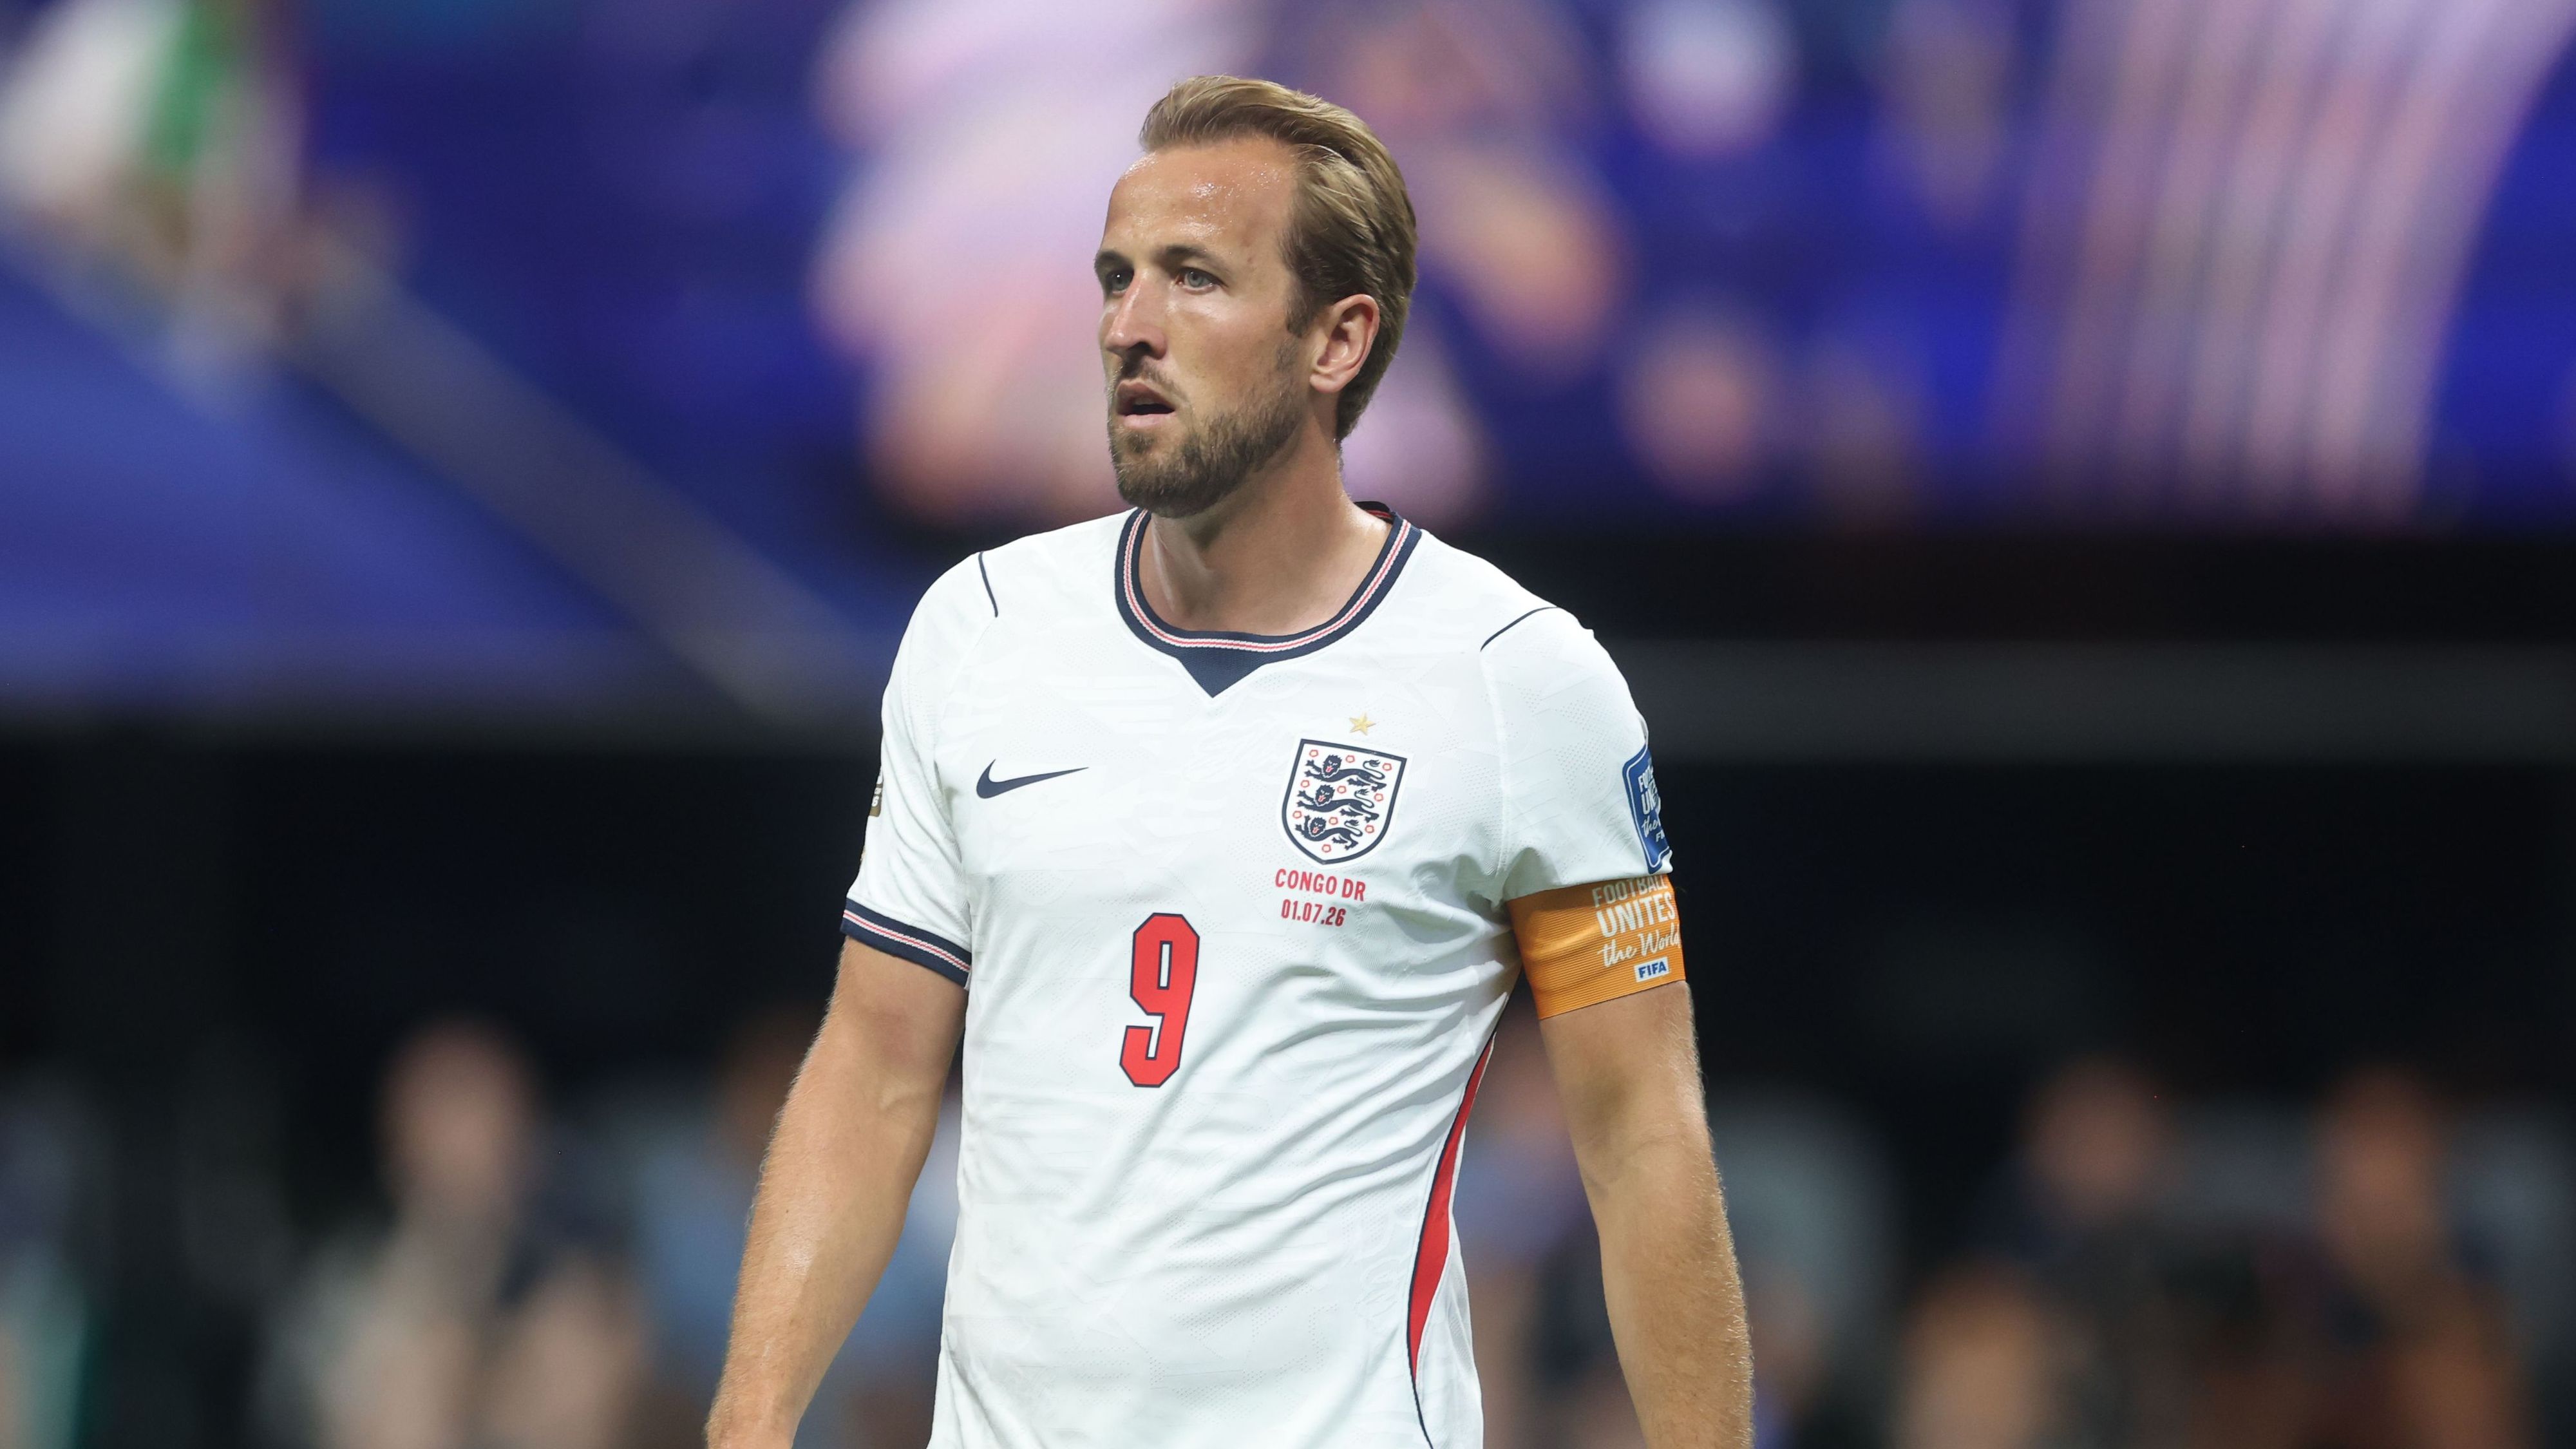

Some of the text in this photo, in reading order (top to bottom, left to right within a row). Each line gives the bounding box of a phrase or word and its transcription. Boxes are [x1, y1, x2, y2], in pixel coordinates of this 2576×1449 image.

[1275, 869, 1366, 902] CONGO DR
[1592, 875, 1668, 907] FOOTBALL
[1281, 899, 1347, 927] 01.07.26
[1596, 891, 1675, 938] UNITES
[1597, 939, 1637, 967] the
[1638, 961, 1667, 978] FIFA
[1119, 913, 1200, 1088] 9
